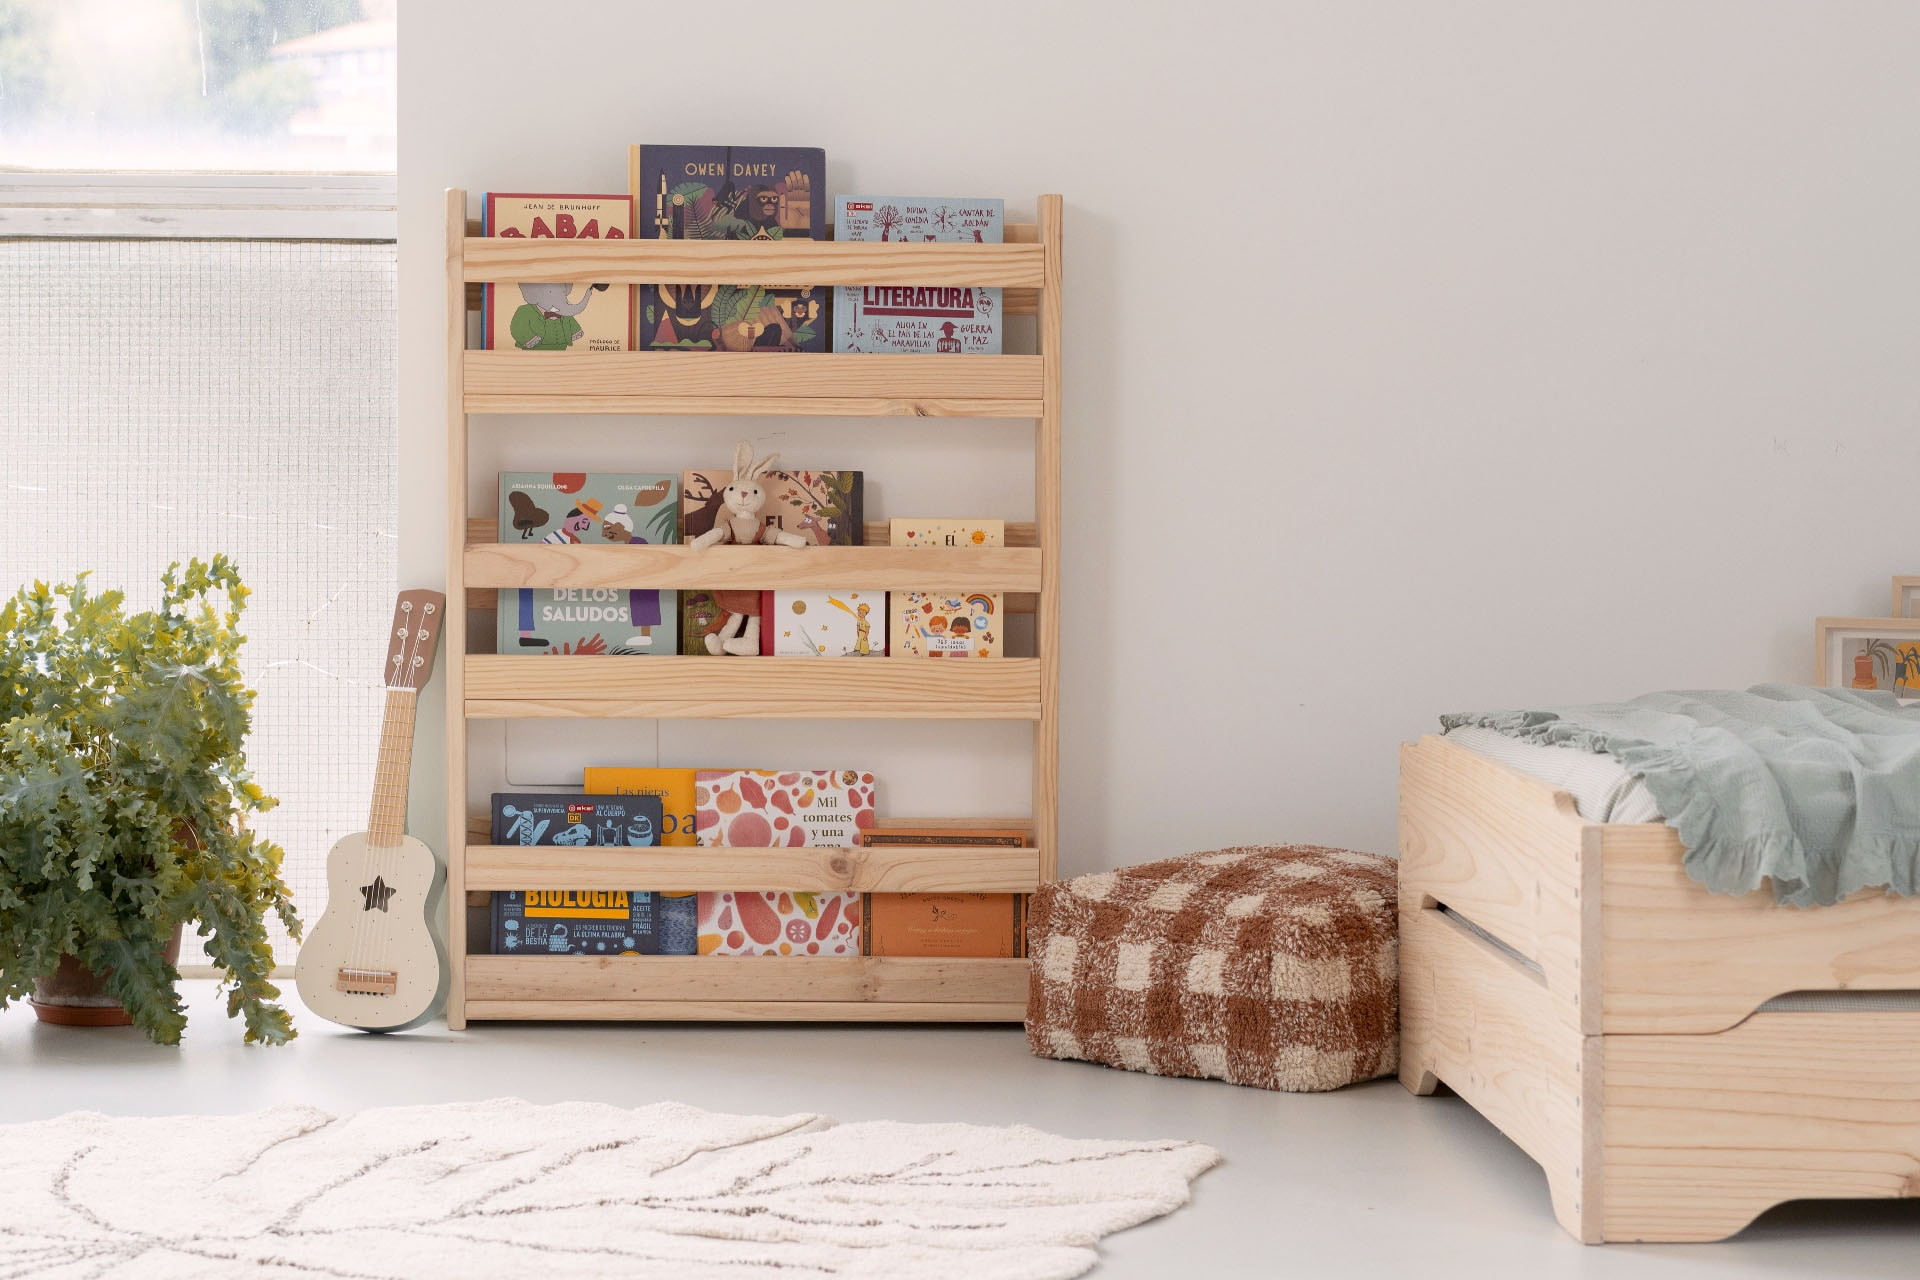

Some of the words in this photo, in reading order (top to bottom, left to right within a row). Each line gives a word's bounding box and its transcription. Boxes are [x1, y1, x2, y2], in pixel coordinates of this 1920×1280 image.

[685, 162, 725, 176] OWEN
[733, 163, 777, 177] DAVEY
[906, 207, 928, 215] DIVINA
[959, 208, 984, 218] CANTAR
[863, 286, 974, 309] LITERATURA
[896, 321, 916, 329] ALICIA
[960, 325, 993, 334] GUERRA
[888, 330, 896, 338] EL
[891, 340, 931, 348] MARAVILLAS
[963, 336, 969, 345] Y
[972, 335, 989, 345] PAZ
[945, 534, 957, 546] EL
[553, 588, 579, 602] DE
[582, 588, 619, 602] LOS
[542, 605, 628, 622] SALUDOS
[817, 796, 837, 808] Mil
[803, 814, 852, 823] tomates
[811, 829, 818, 841] y
[821, 829, 844, 837] una
[525, 927, 535, 937] DE
[538, 928, 548, 938] LA
[525, 938, 548, 946] BESTIA
